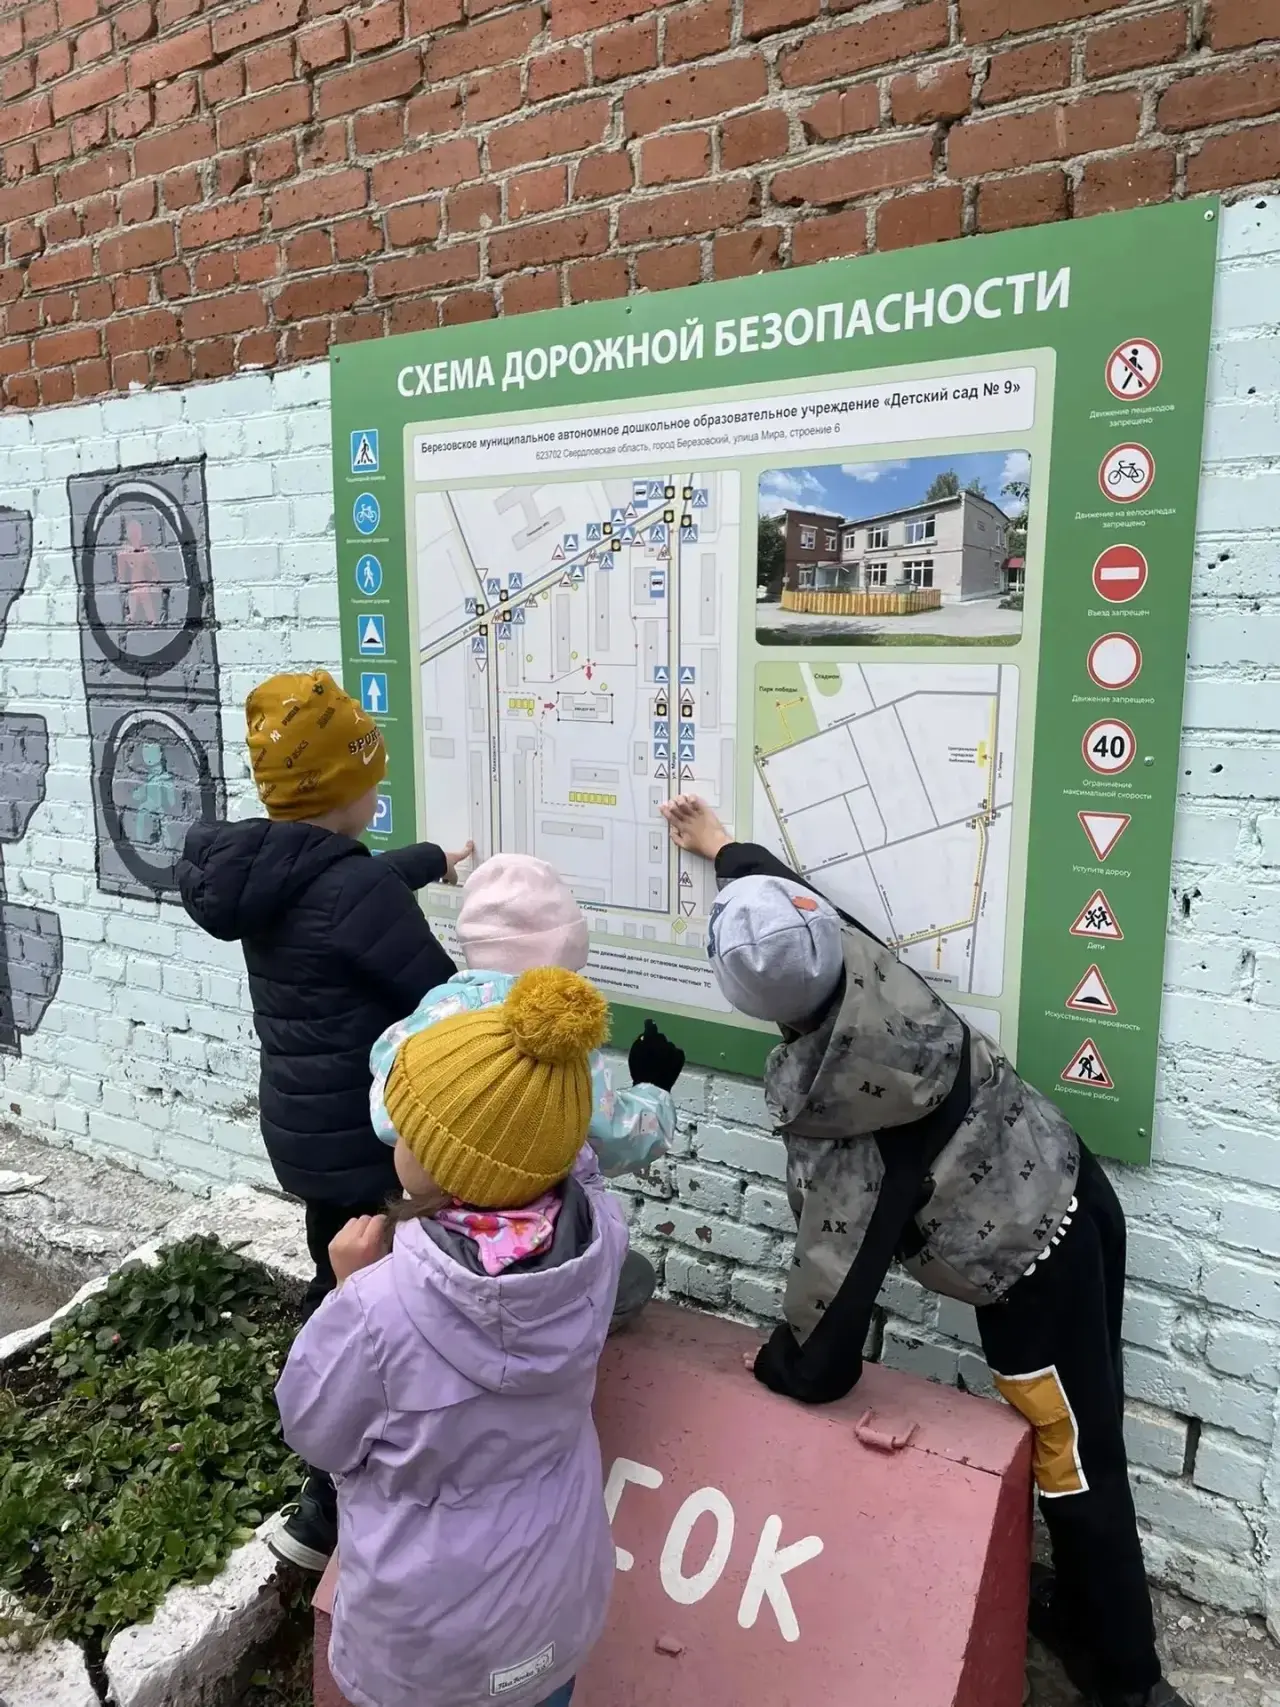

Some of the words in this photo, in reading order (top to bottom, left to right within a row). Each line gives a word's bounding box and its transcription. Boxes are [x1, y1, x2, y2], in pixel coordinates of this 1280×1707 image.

[397, 355, 496, 397] СХЕМА
[502, 316, 704, 392] ДОРОЖНОЙ
[714, 266, 1071, 357] БЕЗОПАСНОСТИ
[421, 441, 477, 455] Березовское
[479, 432, 555, 450] муниципальное
[557, 426, 620, 441] автономное
[622, 418, 690, 437] дошкольное
[693, 405, 798, 428] образовательное
[801, 394, 880, 418] учреждение
[884, 387, 949, 408] «Детский
[952, 386, 979, 400] сад
[983, 381, 1000, 396] №
[1004, 380, 1021, 394] 9»
[1089, 408, 1130, 419] Движение
[1109, 417, 1153, 427] запрещено
[536, 448, 562, 461] 623702
[563, 444, 616, 460] Свердловская
[617, 441, 650, 453] область,
[652, 441, 676, 451] город
[677, 435, 731, 448] Березовский,
[733, 433, 759, 445] улица
[761, 430, 788, 441] Мира,
[790, 424, 832, 438] строение
[834, 422, 841, 433] 6
[1075, 509, 1115, 520] Движение
[1103, 520, 1146, 529] запрещено
[1112, 609, 1150, 618] запрещен
[1072, 694, 1111, 703] Движение
[1112, 695, 1155, 704] запрещено
[1092, 735, 1126, 759] 40
[1082, 779, 1133, 789] Ограничение
[1072, 864, 1105, 875] Уступите
[1105, 867, 1132, 878] дорогу
[1087, 942, 1106, 950] Дети
[1044, 1010, 1097, 1025] Искусственная
[1098, 1018, 1141, 1032] неровность
[859, 1081, 887, 1099] AX
[1054, 1084, 1093, 1098] Дорожные
[1004, 1102, 1025, 1127] AX
[969, 1160, 993, 1184] AX
[1019, 1160, 1036, 1181] AX
[821, 1219, 848, 1234] AX
[977, 1220, 996, 1240] AX
